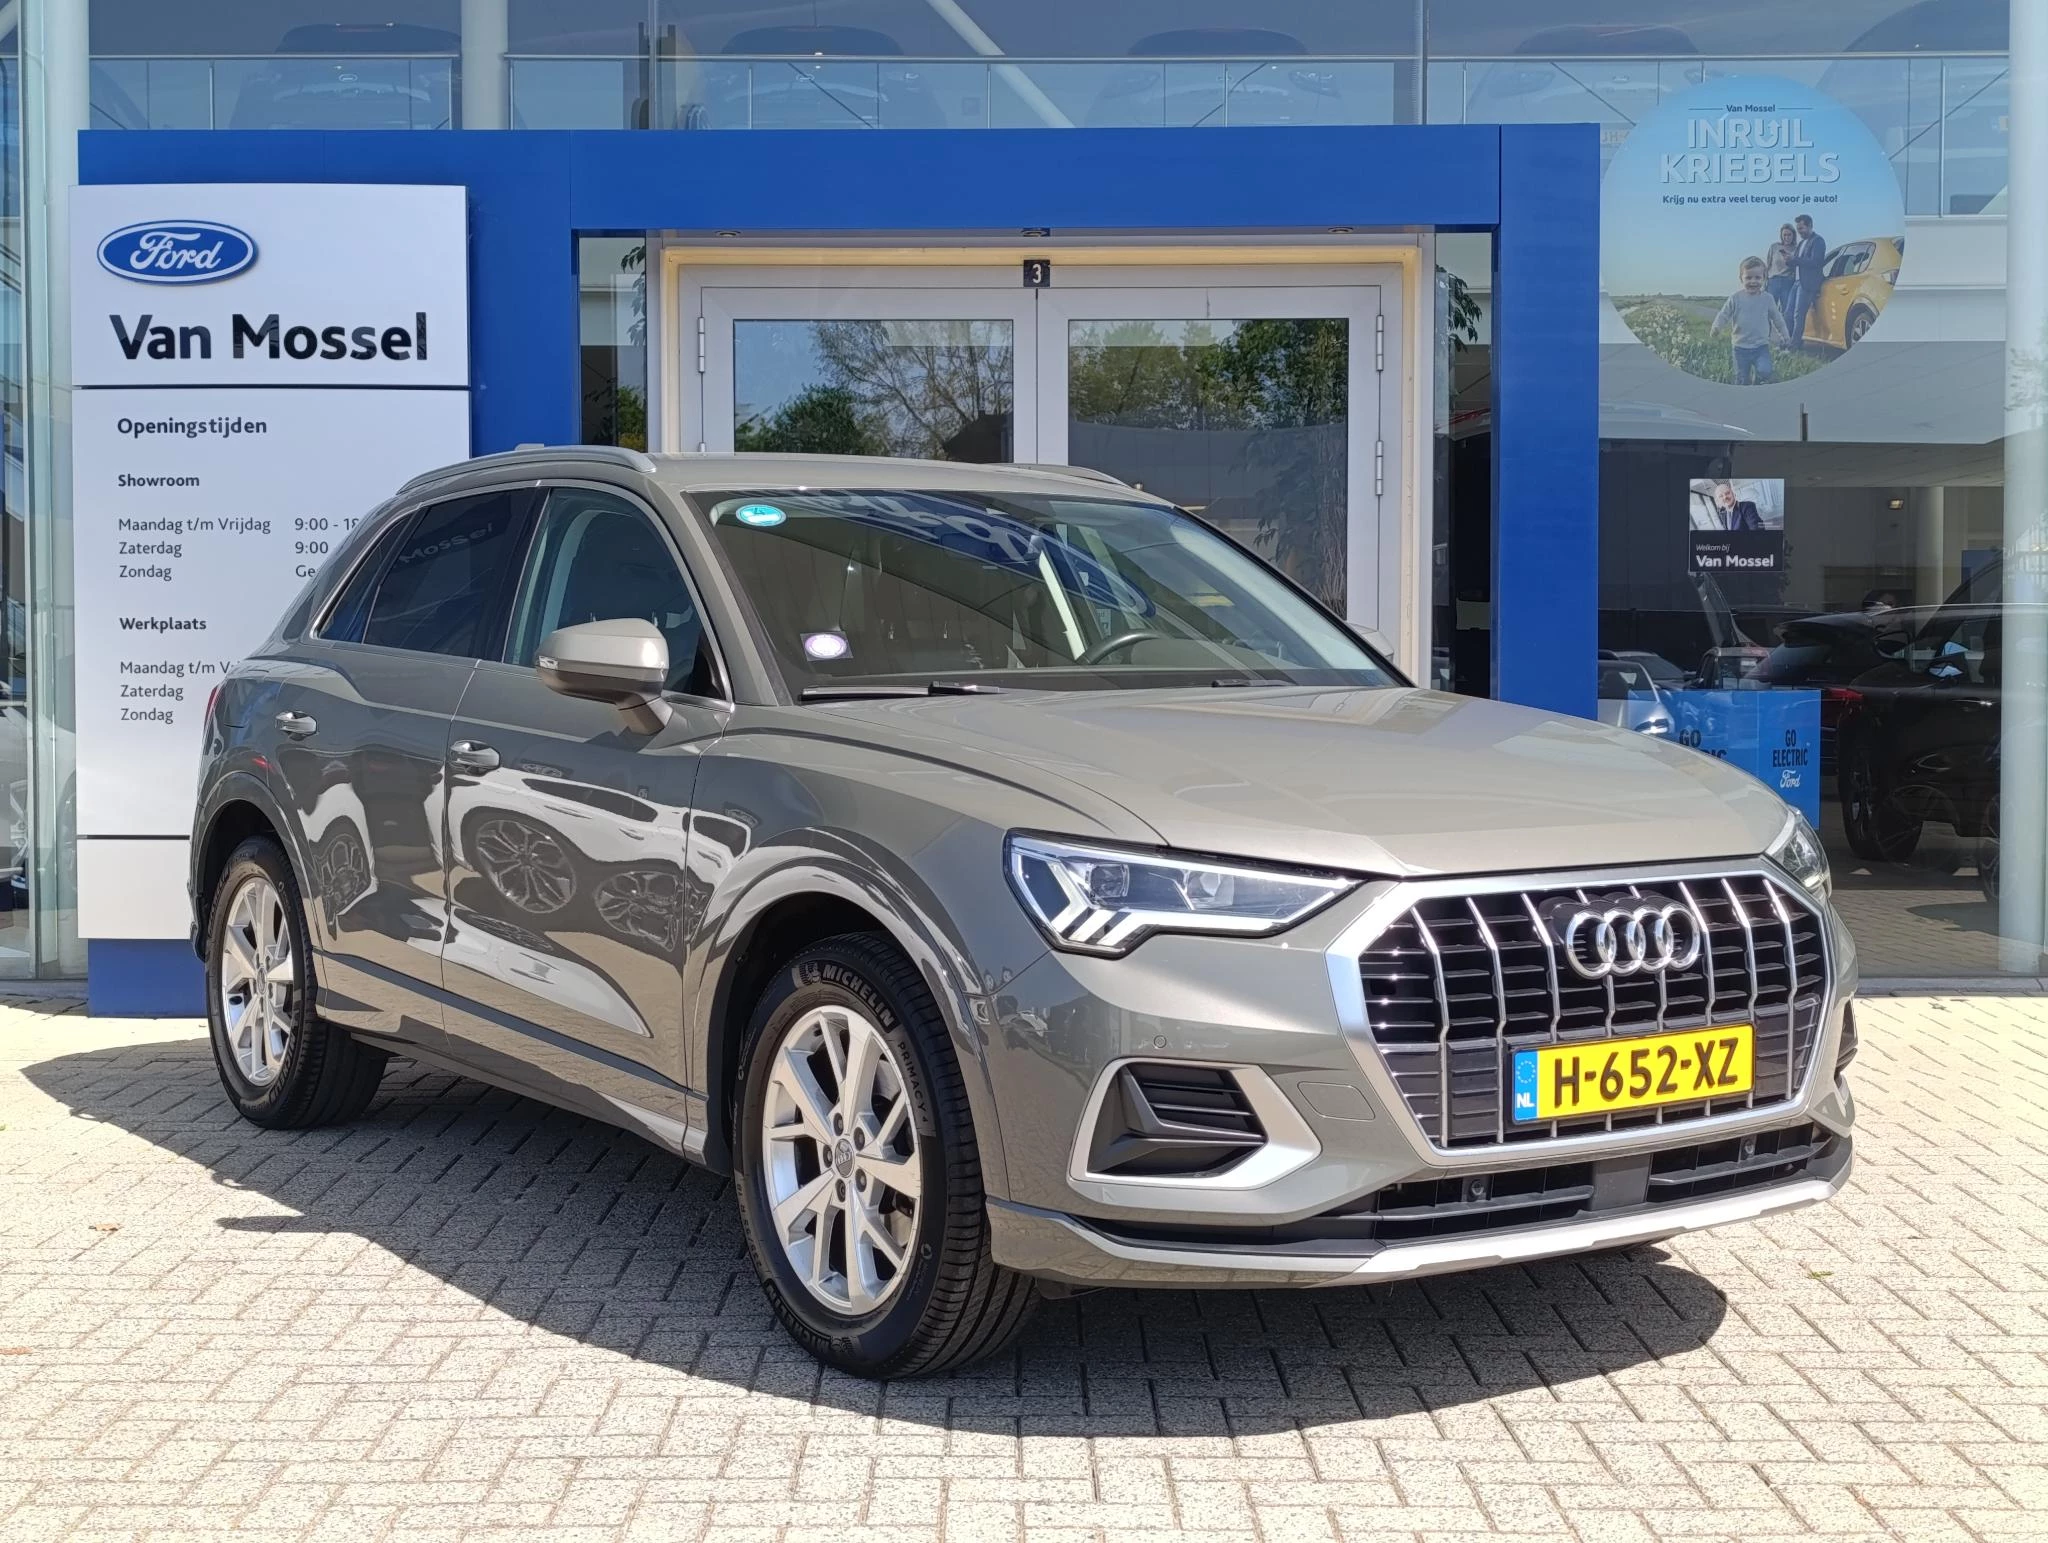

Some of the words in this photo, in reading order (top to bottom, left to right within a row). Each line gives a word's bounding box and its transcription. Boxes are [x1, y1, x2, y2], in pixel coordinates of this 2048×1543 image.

[1745, 104, 1776, 112] Mossel
[1687, 118, 1814, 149] INRUIL
[1660, 152, 1841, 184] KRIEBELS
[1662, 194, 1685, 205] Krijg
[1687, 196, 1699, 204] nu
[1701, 195, 1726, 204] extra
[1728, 194, 1749, 203] veel
[1751, 195, 1776, 205] terug
[1778, 196, 1800, 204] voor
[1801, 194, 1812, 205] je
[1813, 194, 1838, 204] auto!
[129, 230, 224, 271] Ford
[1032, 263, 1042, 284] 3
[108, 313, 212, 361] Van
[232, 311, 428, 361] Mossel
[117, 417, 268, 439] Openingstijden
[117, 473, 200, 488] Showroom
[118, 517, 184, 535] Maandag
[187, 517, 214, 531] t/m
[218, 517, 272, 535] Vrijdag
[294, 517, 329, 531] 9:00
[119, 541, 183, 558] Zaterdag
[295, 541, 329, 554] 9:00
[1696, 554, 1722, 567] Van
[1725, 553, 1774, 567] Mossel
[119, 565, 173, 582] Zondag
[119, 616, 207, 634] Werkplaats
[120, 660, 185, 678] Maandag
[188, 660, 215, 674] t/m
[120, 684, 184, 702] Zaterdag
[120, 707, 174, 725] Zondag
[1785, 729, 1797, 748] GO
[1772, 748, 1809, 768] ELECTRIC
[1779, 769, 1801, 789] Ford
[822, 963, 896, 1028] MICHELIN
[897, 1041, 928, 1114] PRIMACY
[1553, 1037, 1740, 1108] H-652-XZ
[1516, 1092, 1535, 1108] NL
